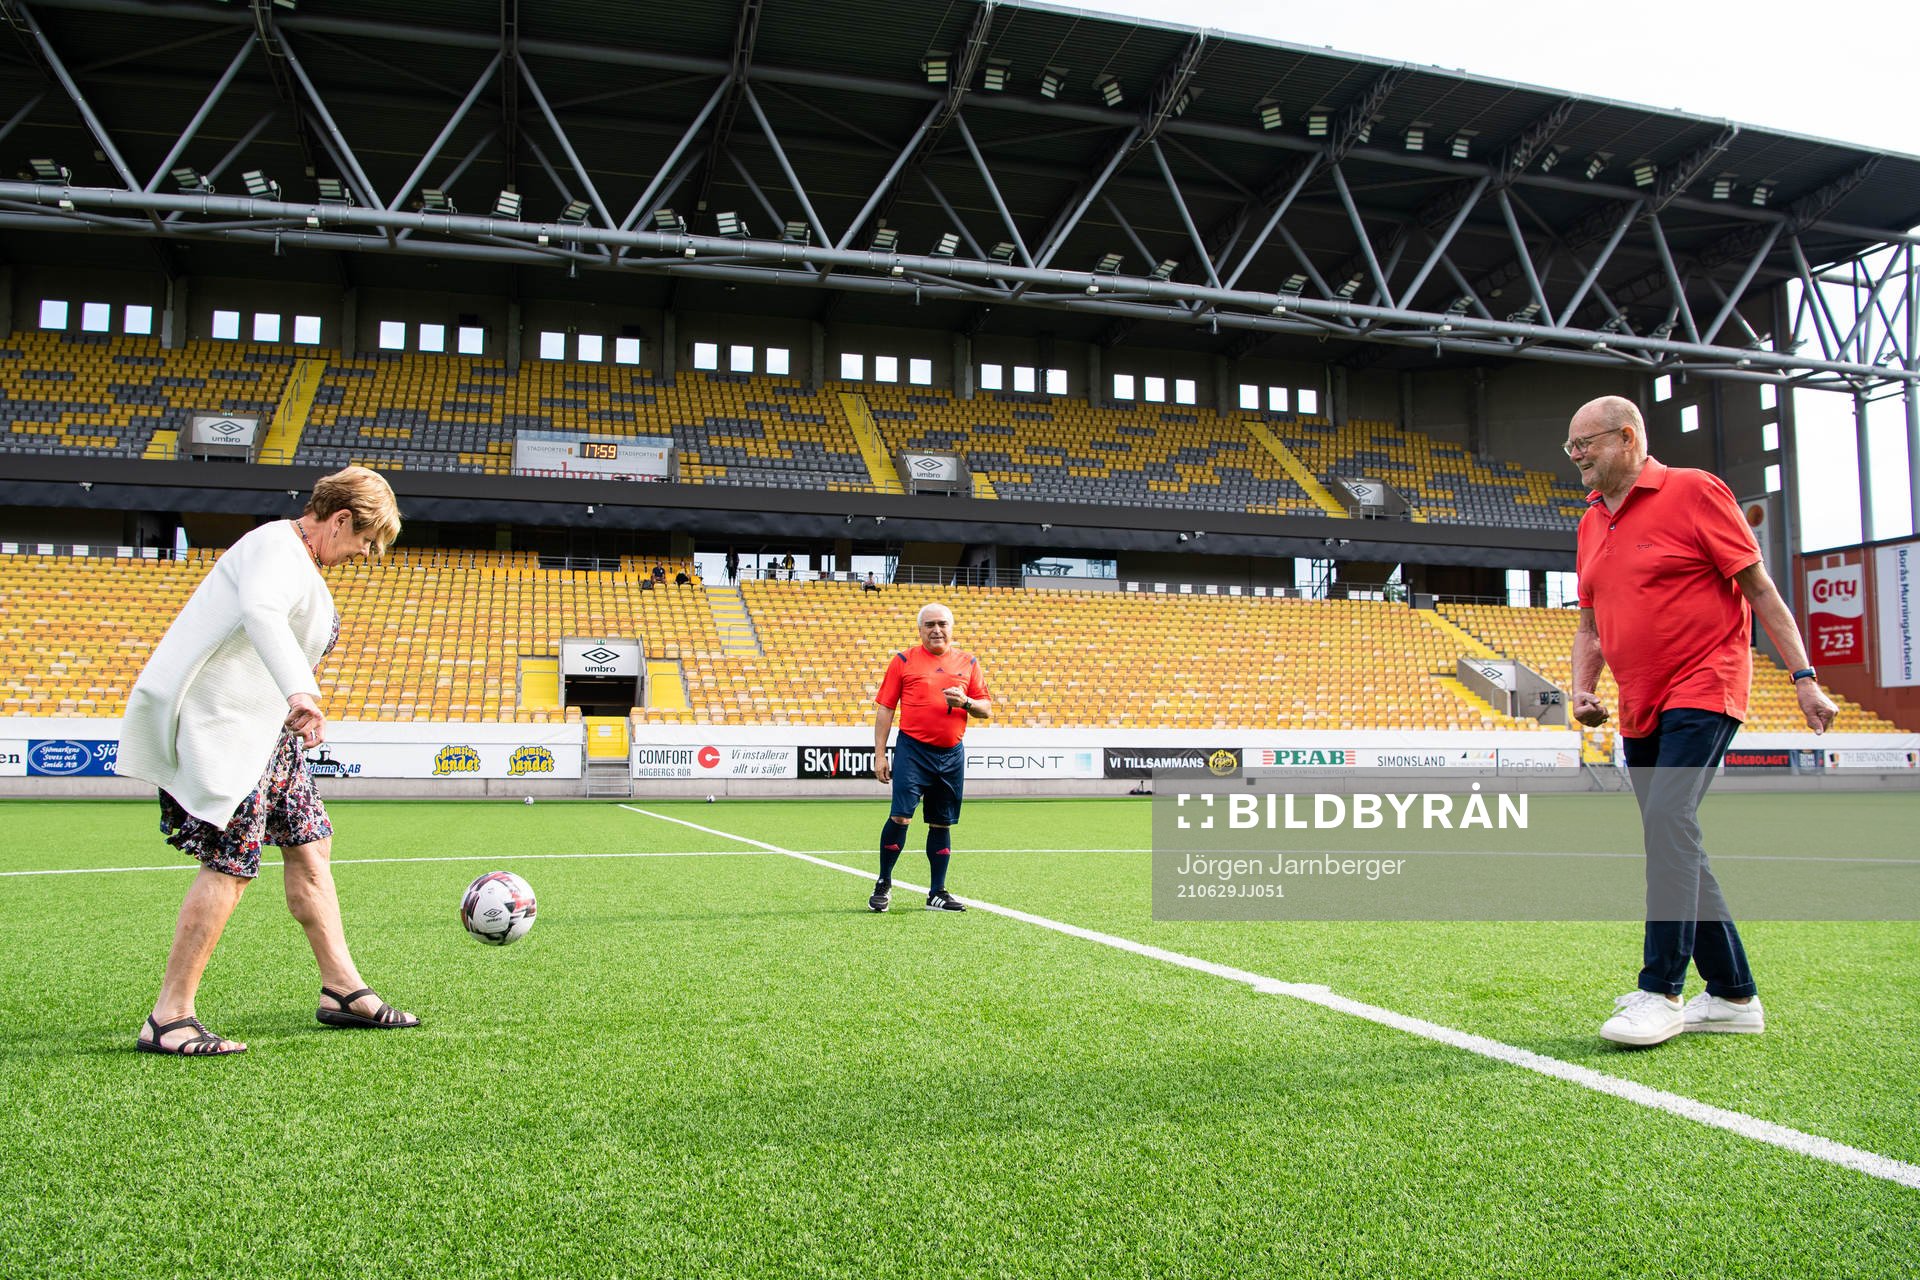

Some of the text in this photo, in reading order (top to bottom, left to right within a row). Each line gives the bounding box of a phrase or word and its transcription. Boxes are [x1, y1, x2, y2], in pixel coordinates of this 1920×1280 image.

[211, 435, 241, 443] umbro
[585, 443, 617, 459] 17:59
[1812, 578, 1858, 604] City
[1819, 632, 1854, 651] 7-23
[584, 665, 617, 673] umbro
[64, 753, 77, 761] och
[440, 744, 479, 759] Blomster
[513, 745, 552, 760] Blomster
[639, 749, 694, 765] COMFORT
[731, 749, 789, 760] Vi installerar
[1273, 750, 1345, 765] PEAB
[432, 753, 481, 776] Landet
[507, 754, 555, 777] Landet
[966, 756, 1064, 769] FRONT
[1109, 757, 1121, 769] VI
[1124, 757, 1205, 769] TILLSAMMANS
[1377, 755, 1446, 767] SIMONSLAND
[1502, 758, 1556, 772] ProFlow
[347, 763, 361, 774] AB
[732, 763, 787, 777] allt vi säljer
